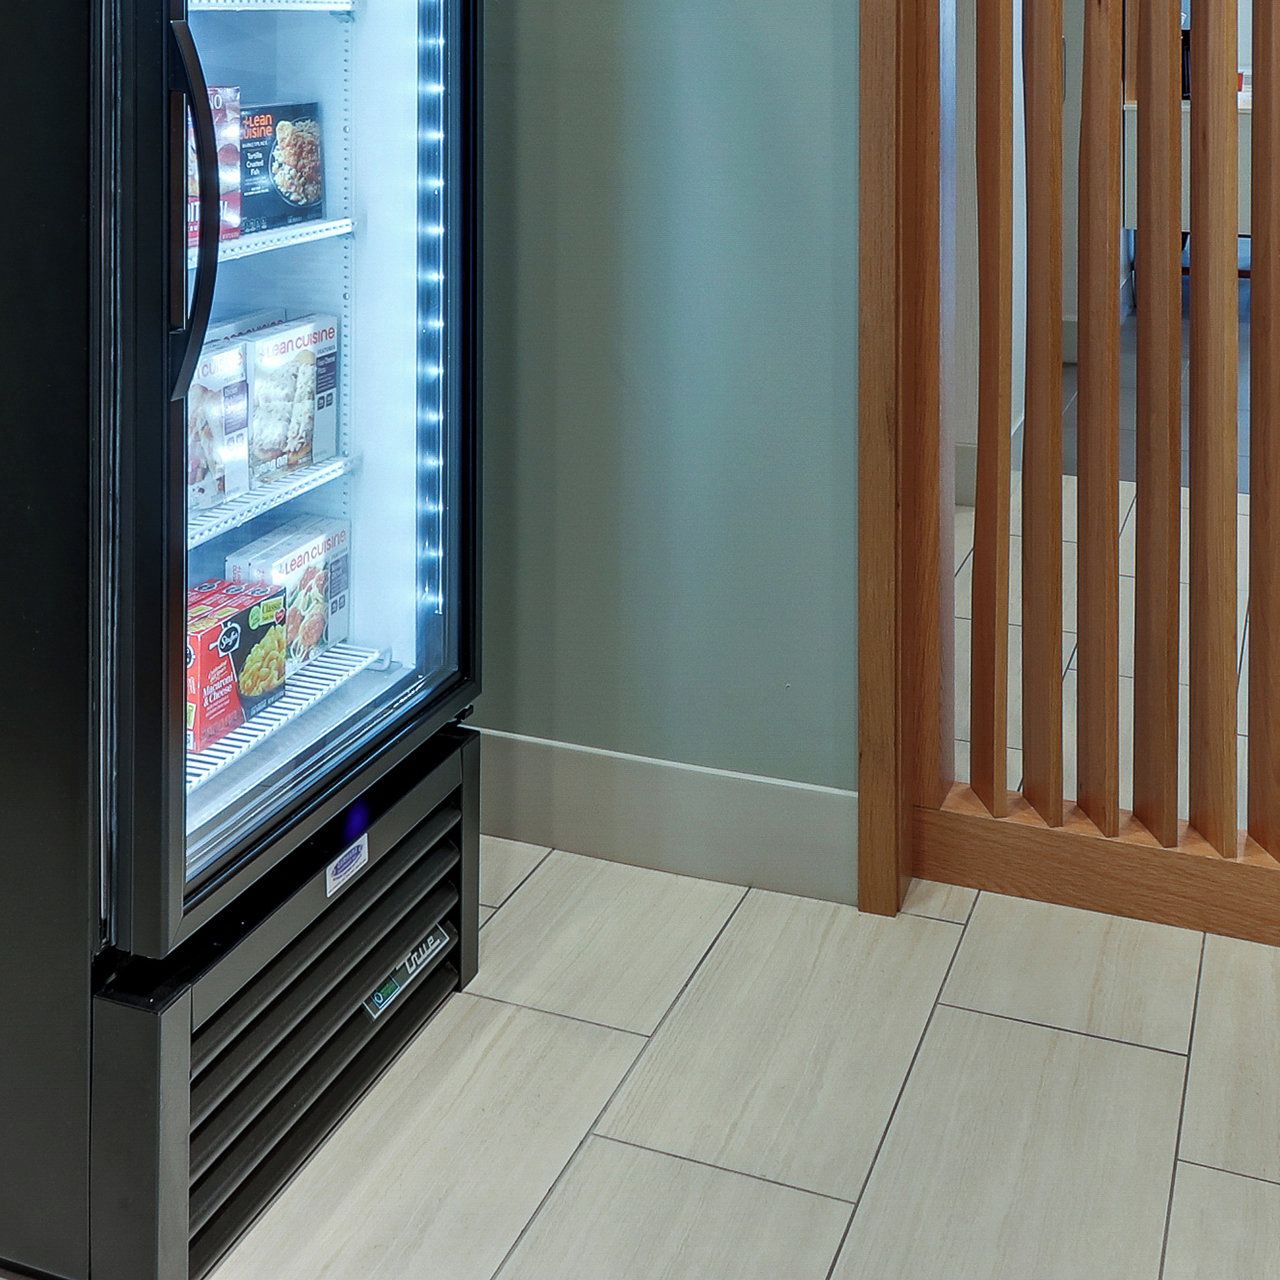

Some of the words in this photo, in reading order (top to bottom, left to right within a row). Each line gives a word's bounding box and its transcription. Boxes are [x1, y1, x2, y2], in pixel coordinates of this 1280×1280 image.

[295, 326, 336, 350] cuisine
[285, 551, 310, 575] Lean
[310, 529, 346, 561] cuisine
